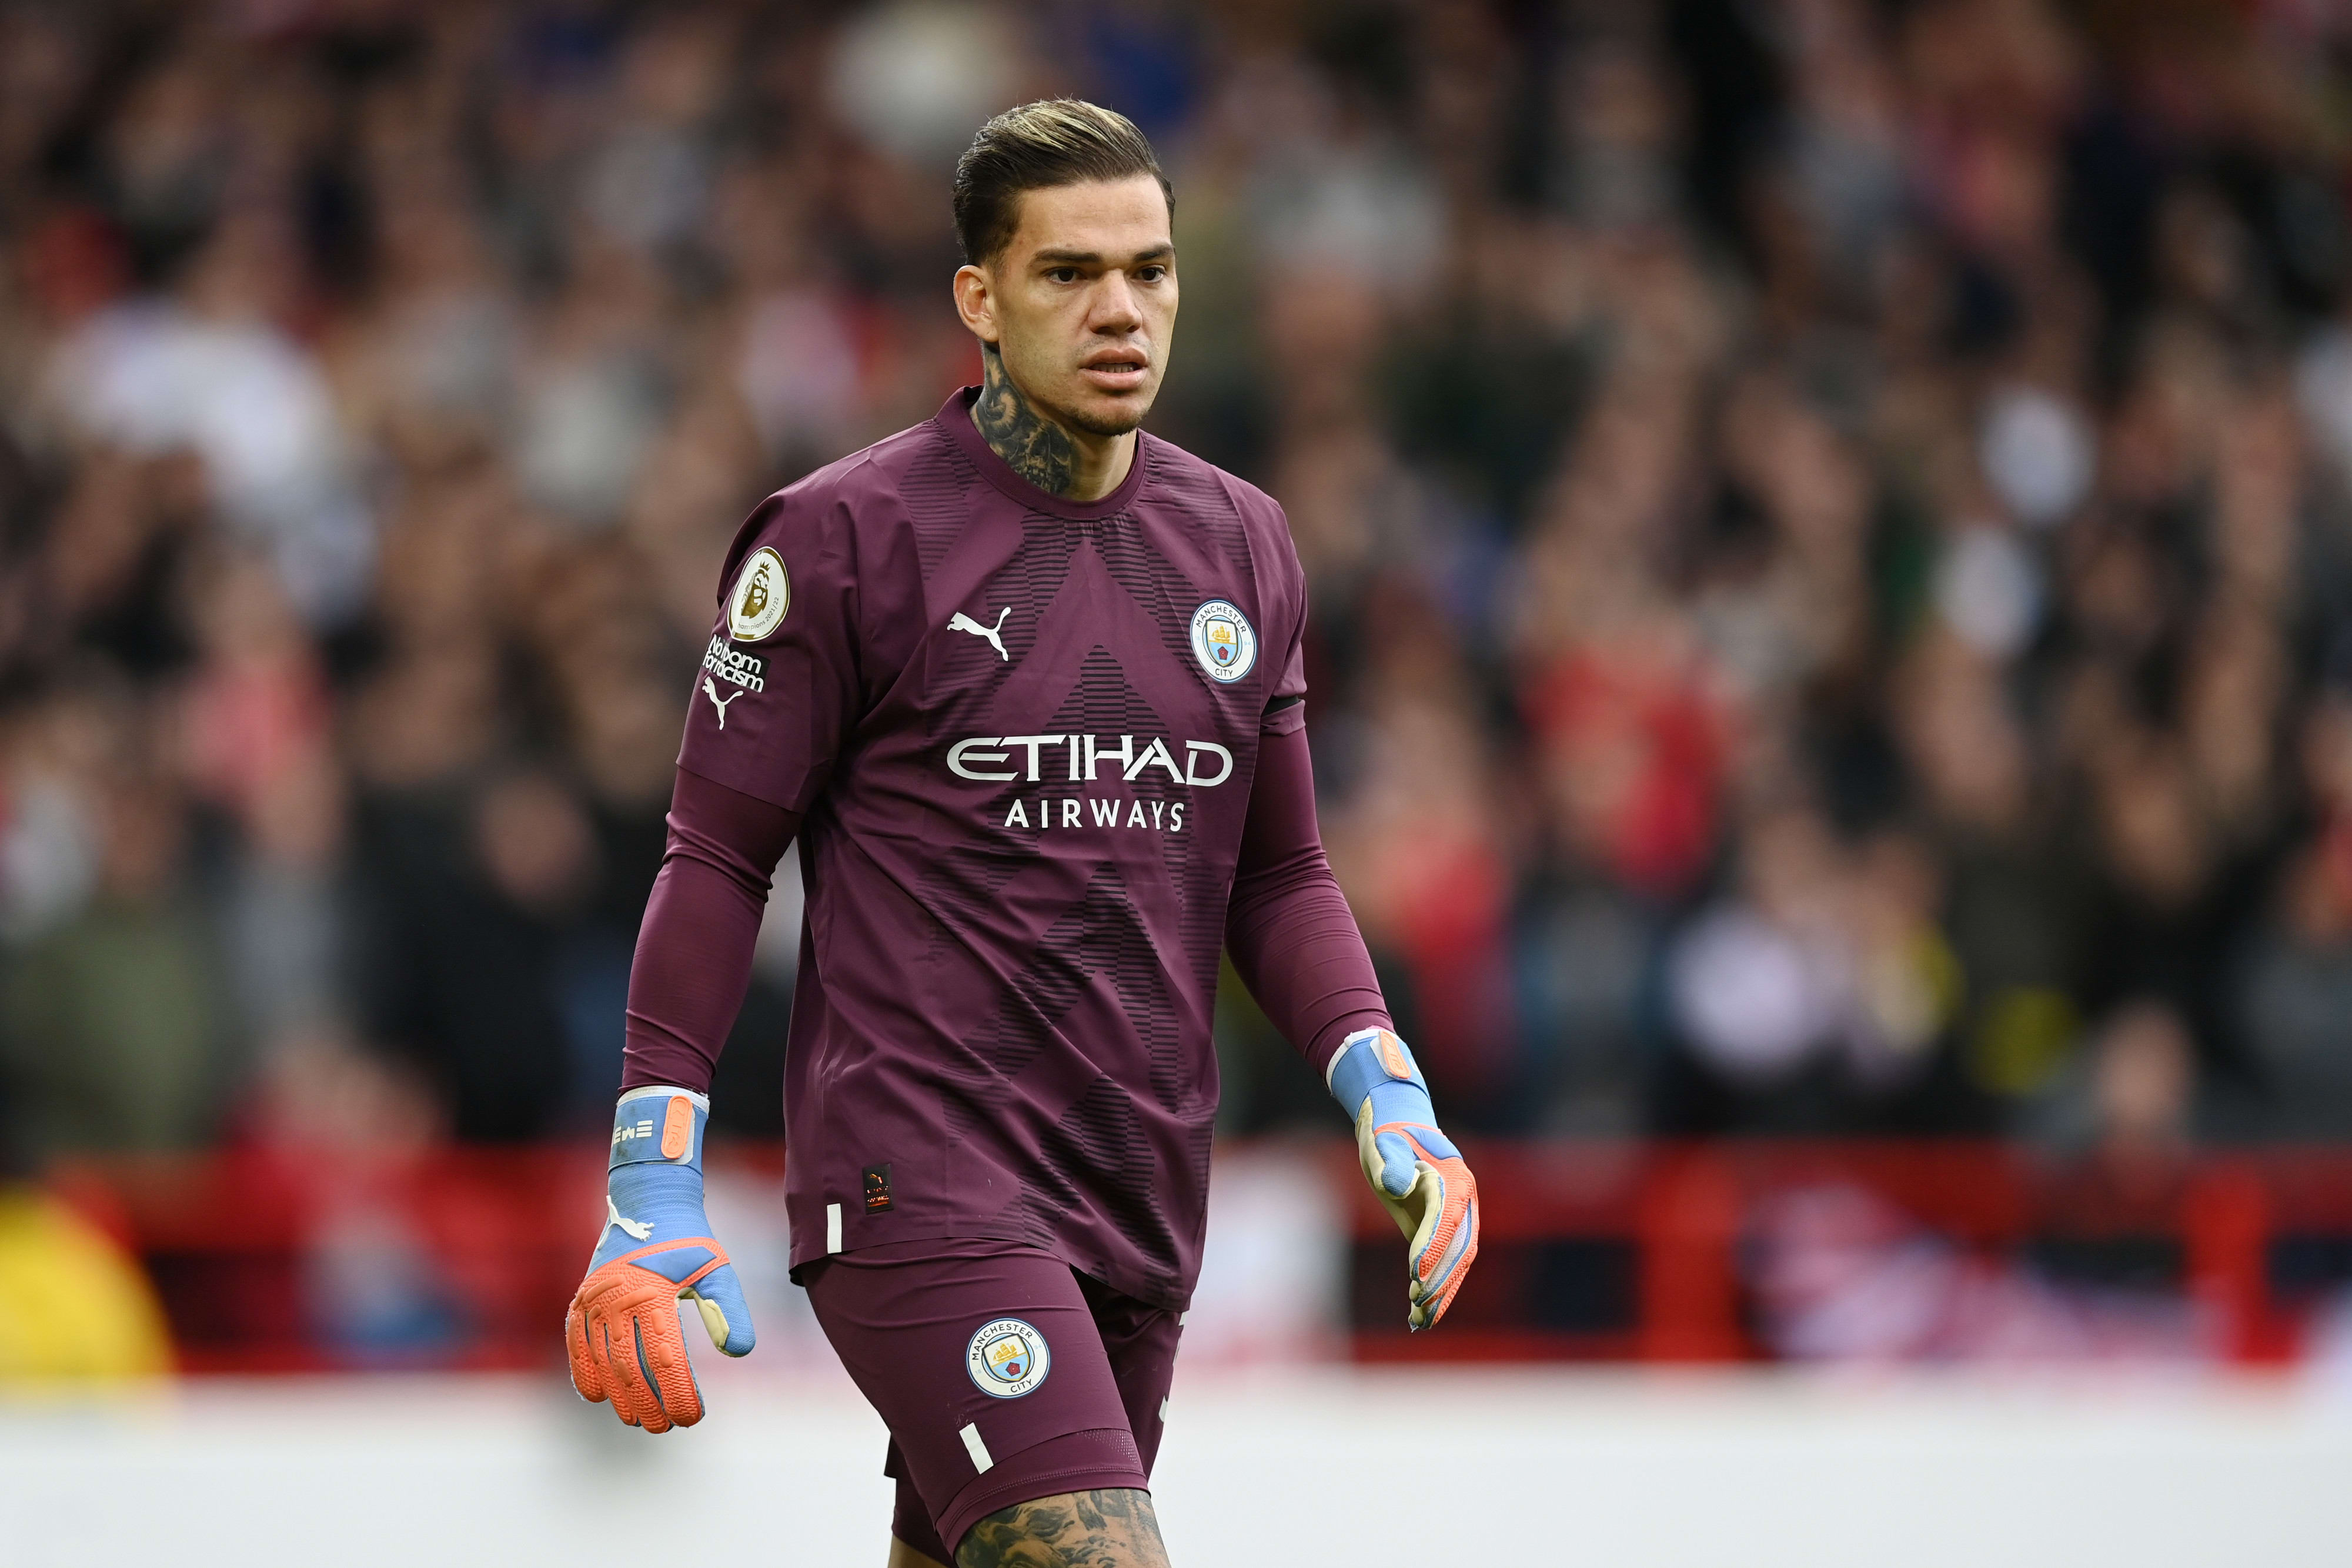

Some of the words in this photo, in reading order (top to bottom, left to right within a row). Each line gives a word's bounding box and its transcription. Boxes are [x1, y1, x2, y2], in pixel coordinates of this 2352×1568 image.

[737, 620, 766, 630] hampions
[765, 597, 779, 622] 2021/22
[1195, 605, 1247, 633] MANCHESTER
[708, 634, 723, 656] No
[702, 649, 717, 670] for
[713, 660, 764, 693] racism
[1215, 668, 1233, 677] CITY
[946, 734, 1233, 787] ETIHAD
[1004, 798, 1185, 832] AIRWAYS
[972, 1323, 1033, 1360] MANCHESTER
[1010, 1379, 1032, 1393] CITY
